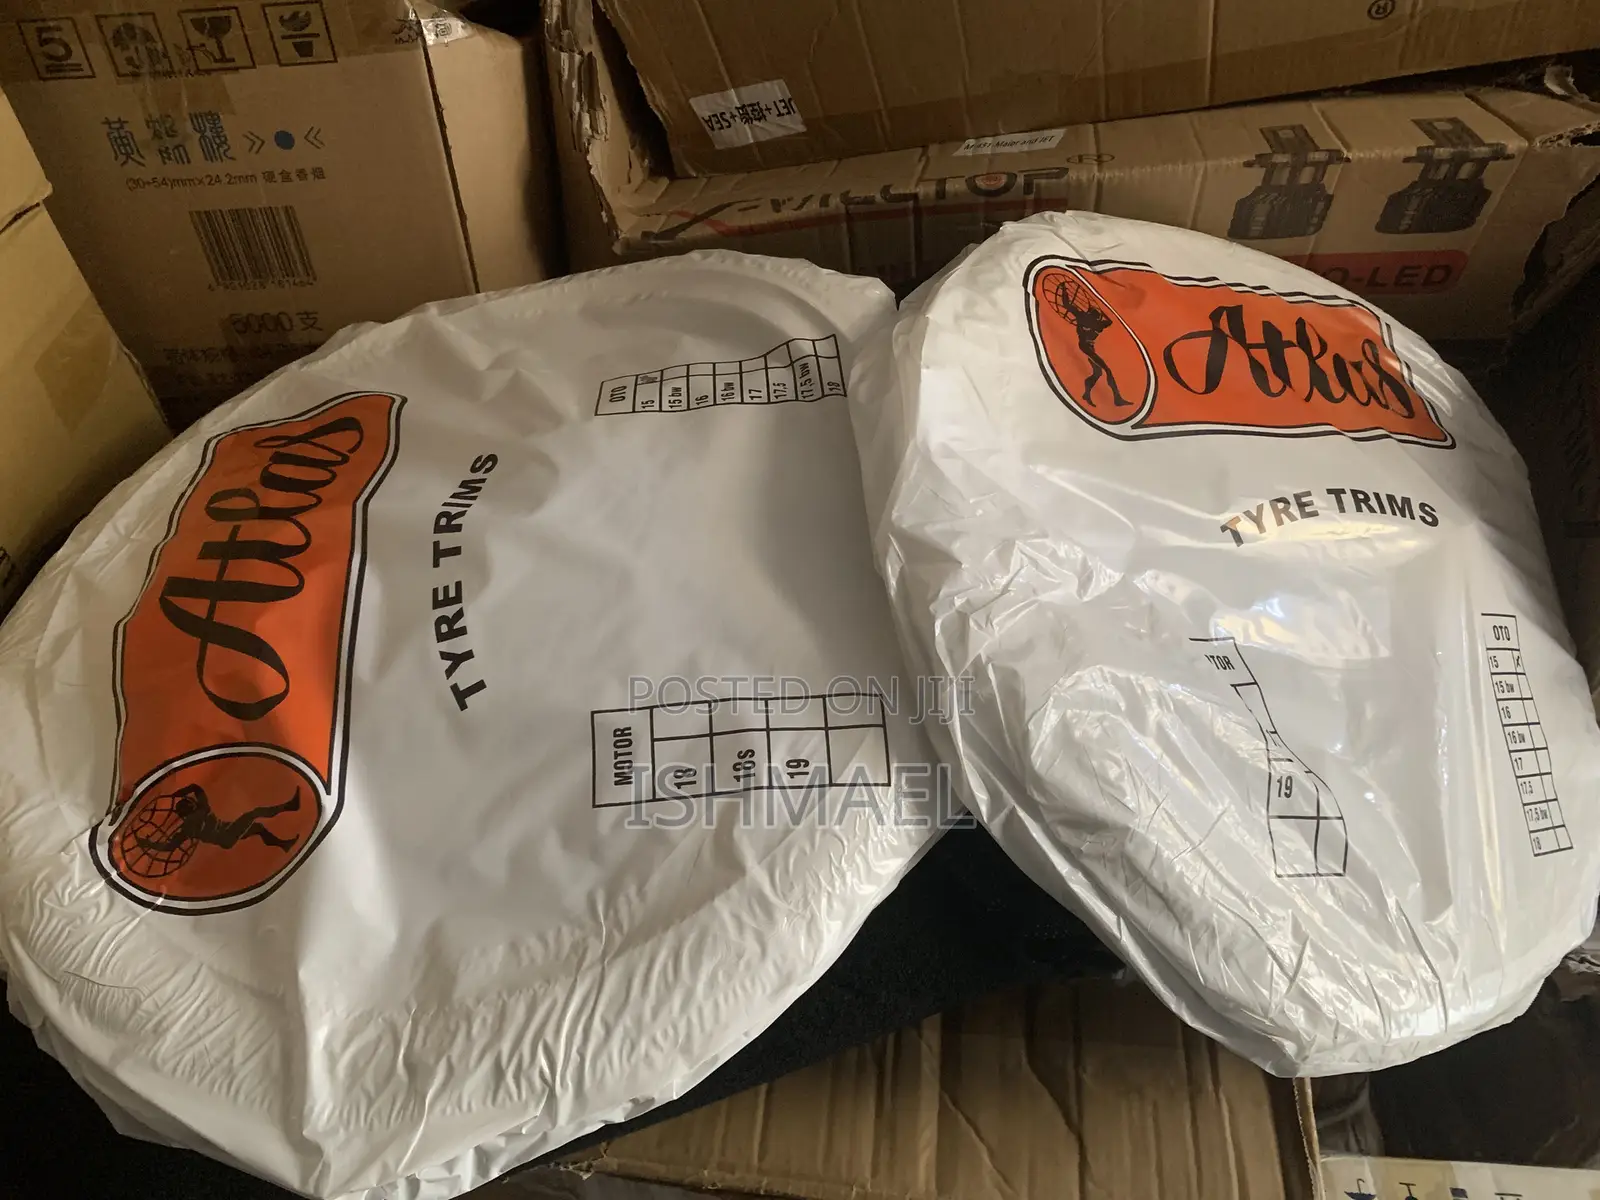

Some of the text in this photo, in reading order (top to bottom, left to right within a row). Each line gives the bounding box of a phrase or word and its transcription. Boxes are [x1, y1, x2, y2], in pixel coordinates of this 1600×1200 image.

[1164, 304, 1415, 418] Atlas
[799, 362, 814, 399] 17,5 bw
[827, 381, 841, 392] 18
[609, 385, 627, 403] OTO
[669, 386, 682, 409] 15 bw
[721, 381, 735, 401] 16 bw
[749, 389, 762, 400] 17
[773, 382, 787, 399] 17,5
[641, 400, 654, 409] 15
[695, 394, 708, 406] 16
[1220, 488, 1439, 547] TYRE TRIMS
[158, 416, 364, 721] Atlas
[432, 452, 499, 711] TYRE TRIMS
[1493, 625, 1510, 641] OTO
[1205, 654, 1235, 671] TOR
[1489, 656, 1499, 668] 15
[1495, 681, 1515, 694] 15 bw
[1501, 706, 1512, 719] 16
[1507, 731, 1517, 744] 16
[613, 726, 633, 786] MOTOR
[1514, 757, 1523, 770] 17
[785, 758, 810, 779] 19
[674, 767, 697, 789] 18
[1276, 775, 1293, 798] 19
[1532, 837, 1542, 850] 18
